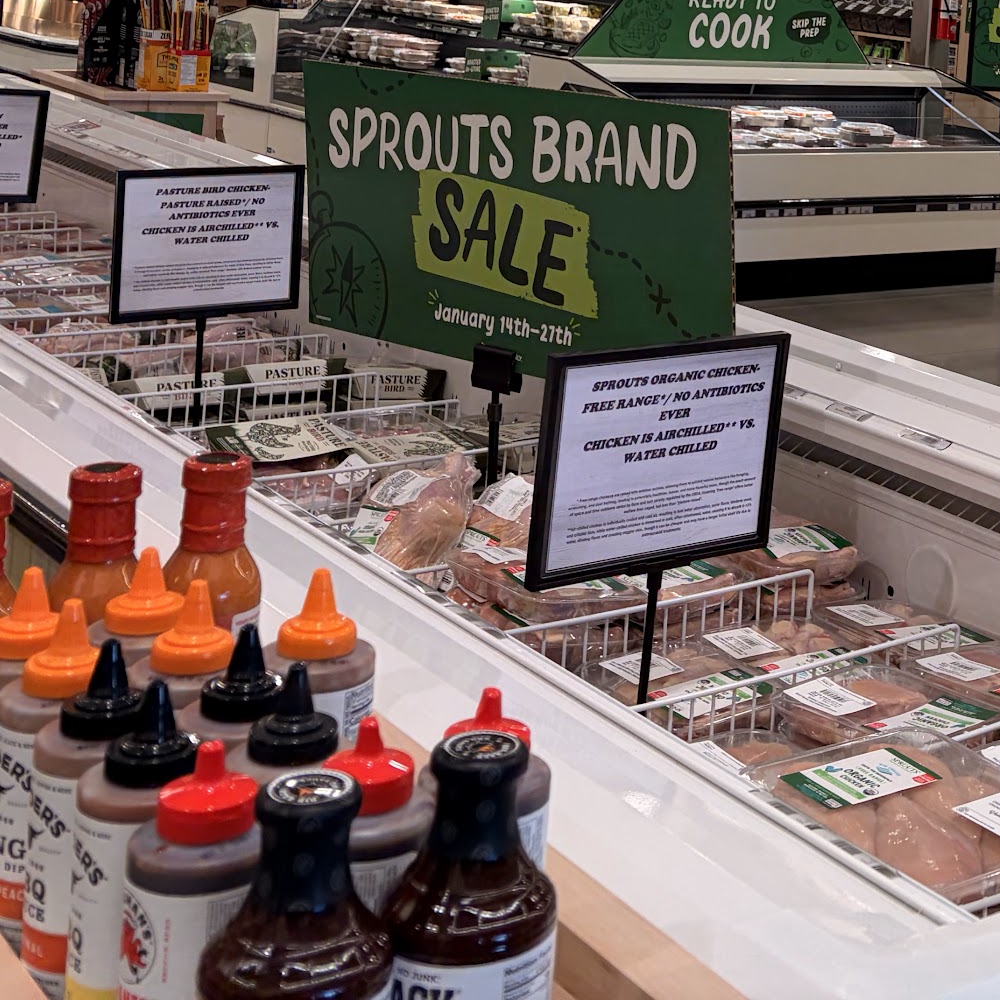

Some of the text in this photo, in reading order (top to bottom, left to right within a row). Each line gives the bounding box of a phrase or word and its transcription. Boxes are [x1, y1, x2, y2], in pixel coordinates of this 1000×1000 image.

[689, 12, 774, 50] COOK
[792, 17, 826, 31] SKIP THE
[800, 28, 819, 39] PREP
[328, 106, 698, 190] SPROUTS BRAND
[155, 187, 201, 197] PASTURE
[202, 186, 225, 195] BIRD
[160, 198, 266, 210] PASTURE NO
[168, 209, 256, 221] ANTIBIOTICS EVER
[142, 226, 187, 236] CHICKEN
[187, 225, 197, 234] IS
[266, 221, 280, 230] VS.
[174, 234, 250, 246] WATER CHILLED
[428, 177, 574, 306] SALE
[434, 301, 495, 336] January
[265, 366, 321, 380] PASTURE
[384, 383, 405, 392] BIRD
[592, 375, 649, 393] SPROUTS
[650, 370, 706, 386] ORGANIC
[581, 381, 766, 415] FREE NO ANTIBIOTICS
[658, 408, 691, 422] EVER
[583, 434, 641, 452] CHICKEN
[640, 432, 655, 445] IS
[739, 418, 756, 431] VS.
[624, 440, 718, 464] WATER CHILLED
[839, 774, 865, 789] CHICKEN
[843, 768, 881, 789] ORGANIC
